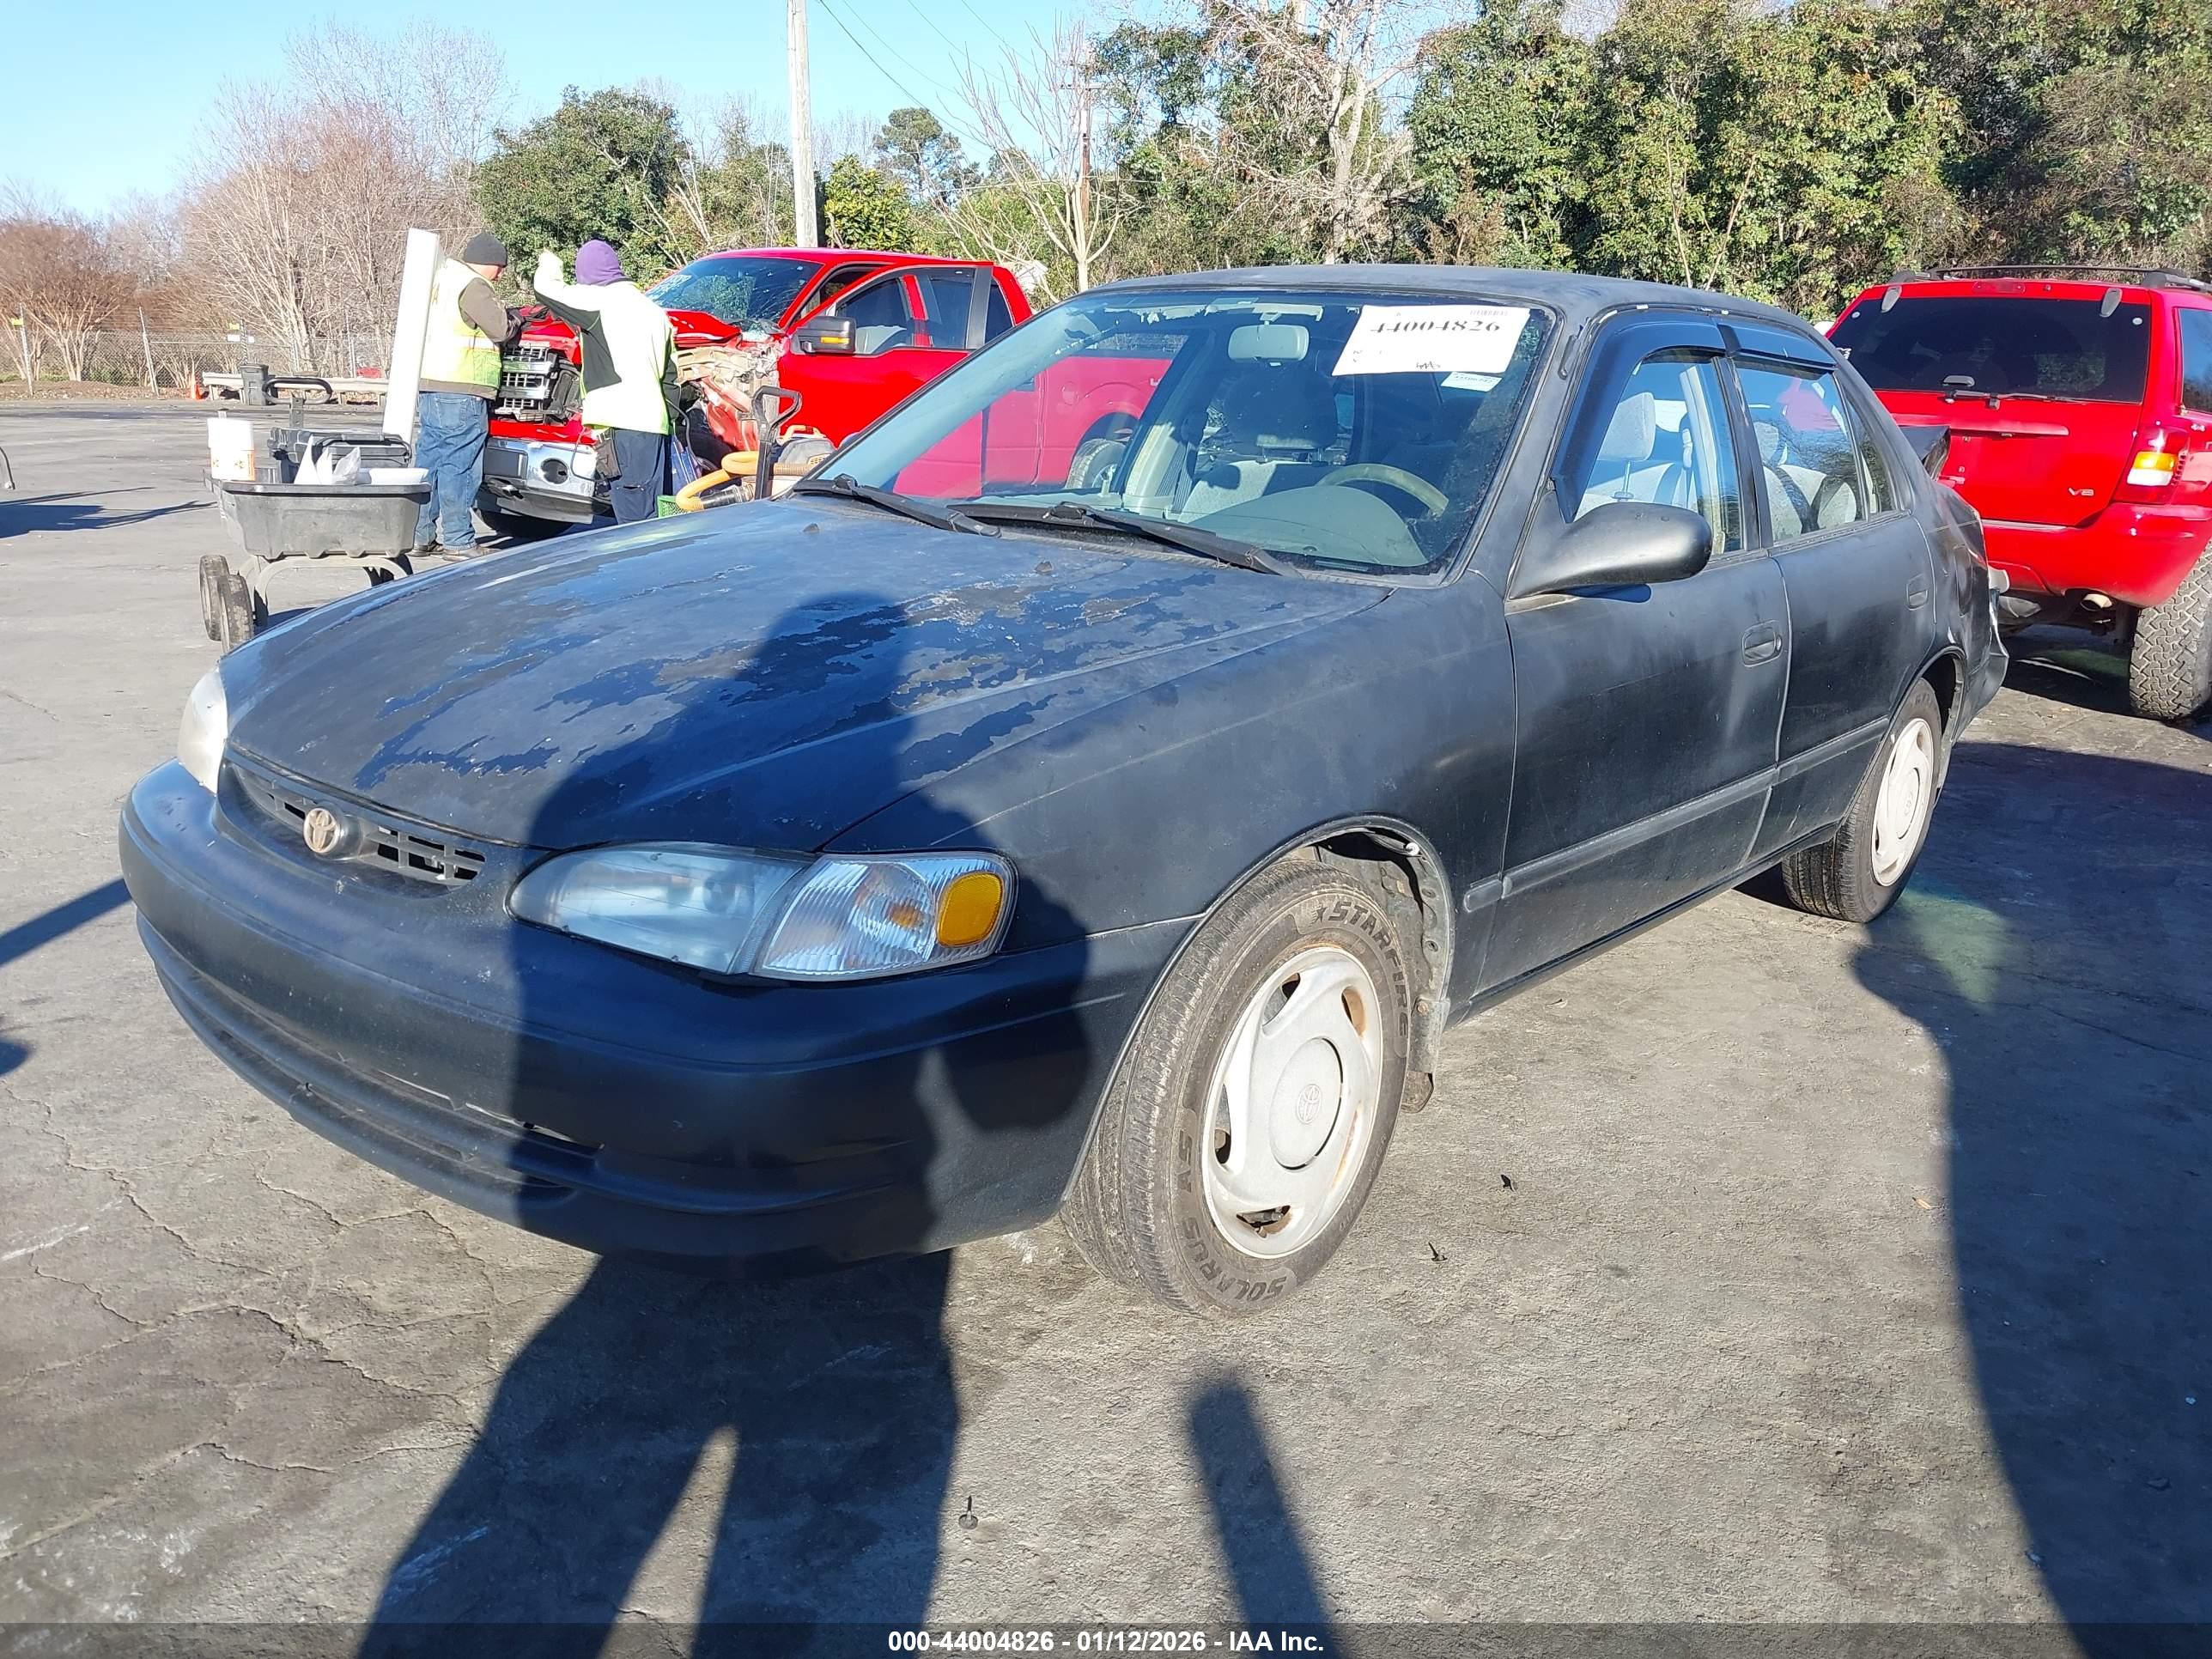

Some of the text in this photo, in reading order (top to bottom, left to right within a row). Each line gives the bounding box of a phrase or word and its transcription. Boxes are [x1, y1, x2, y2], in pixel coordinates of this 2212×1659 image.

[1371, 320, 1500, 333] 44004826
[1328, 900, 1409, 1037] STARFIRE
[1181, 1217, 1288, 1302] SOLARUS
